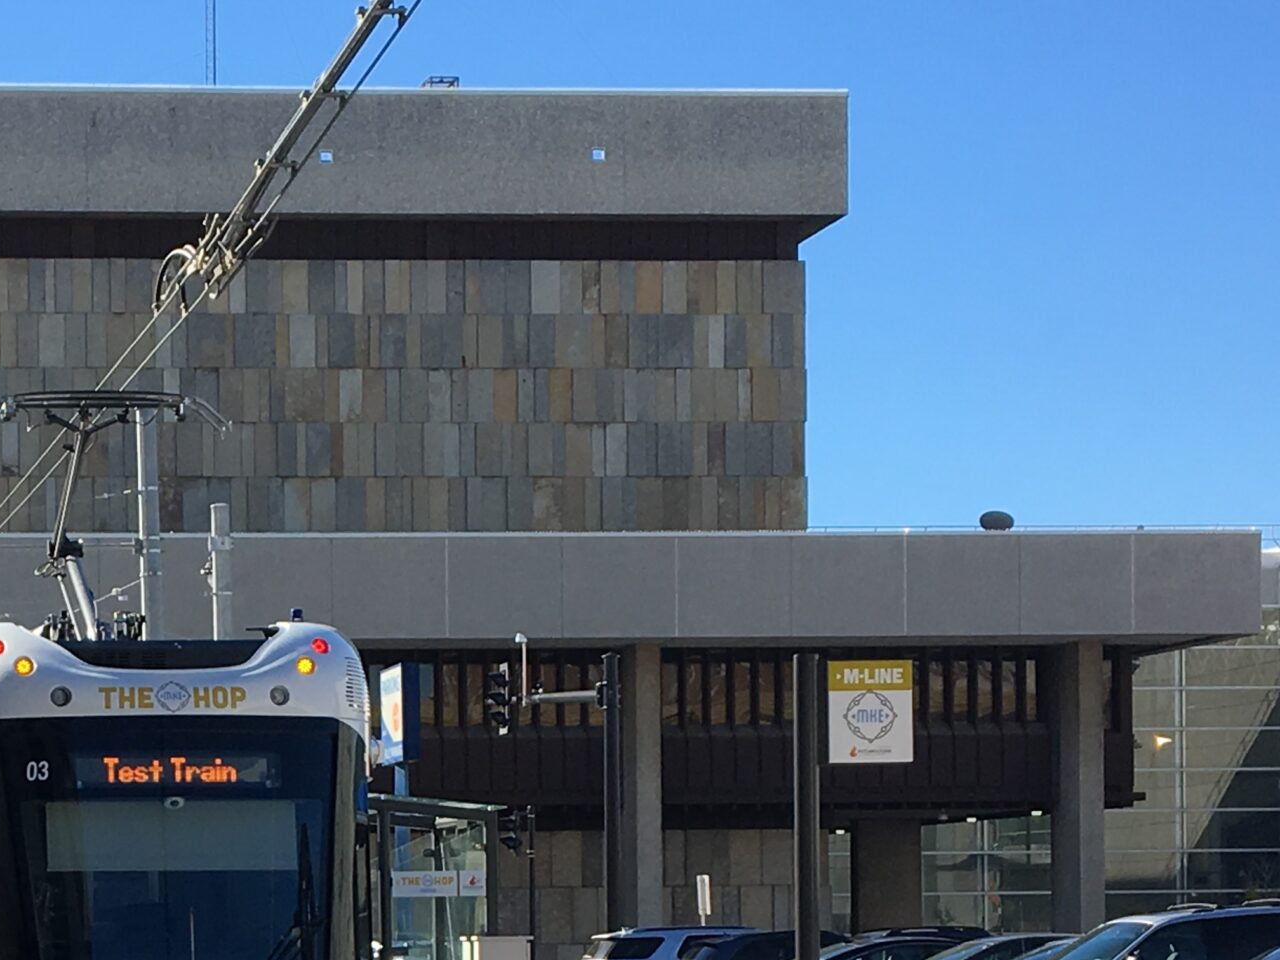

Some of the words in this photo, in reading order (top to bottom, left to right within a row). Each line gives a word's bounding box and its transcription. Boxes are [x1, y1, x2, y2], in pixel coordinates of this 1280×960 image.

[843, 668, 904, 684] M-LINE
[98, 687, 154, 709] THE
[193, 687, 246, 709] HOP
[26, 761, 49, 781] 03
[103, 757, 163, 783] Test
[170, 757, 237, 783] Train
